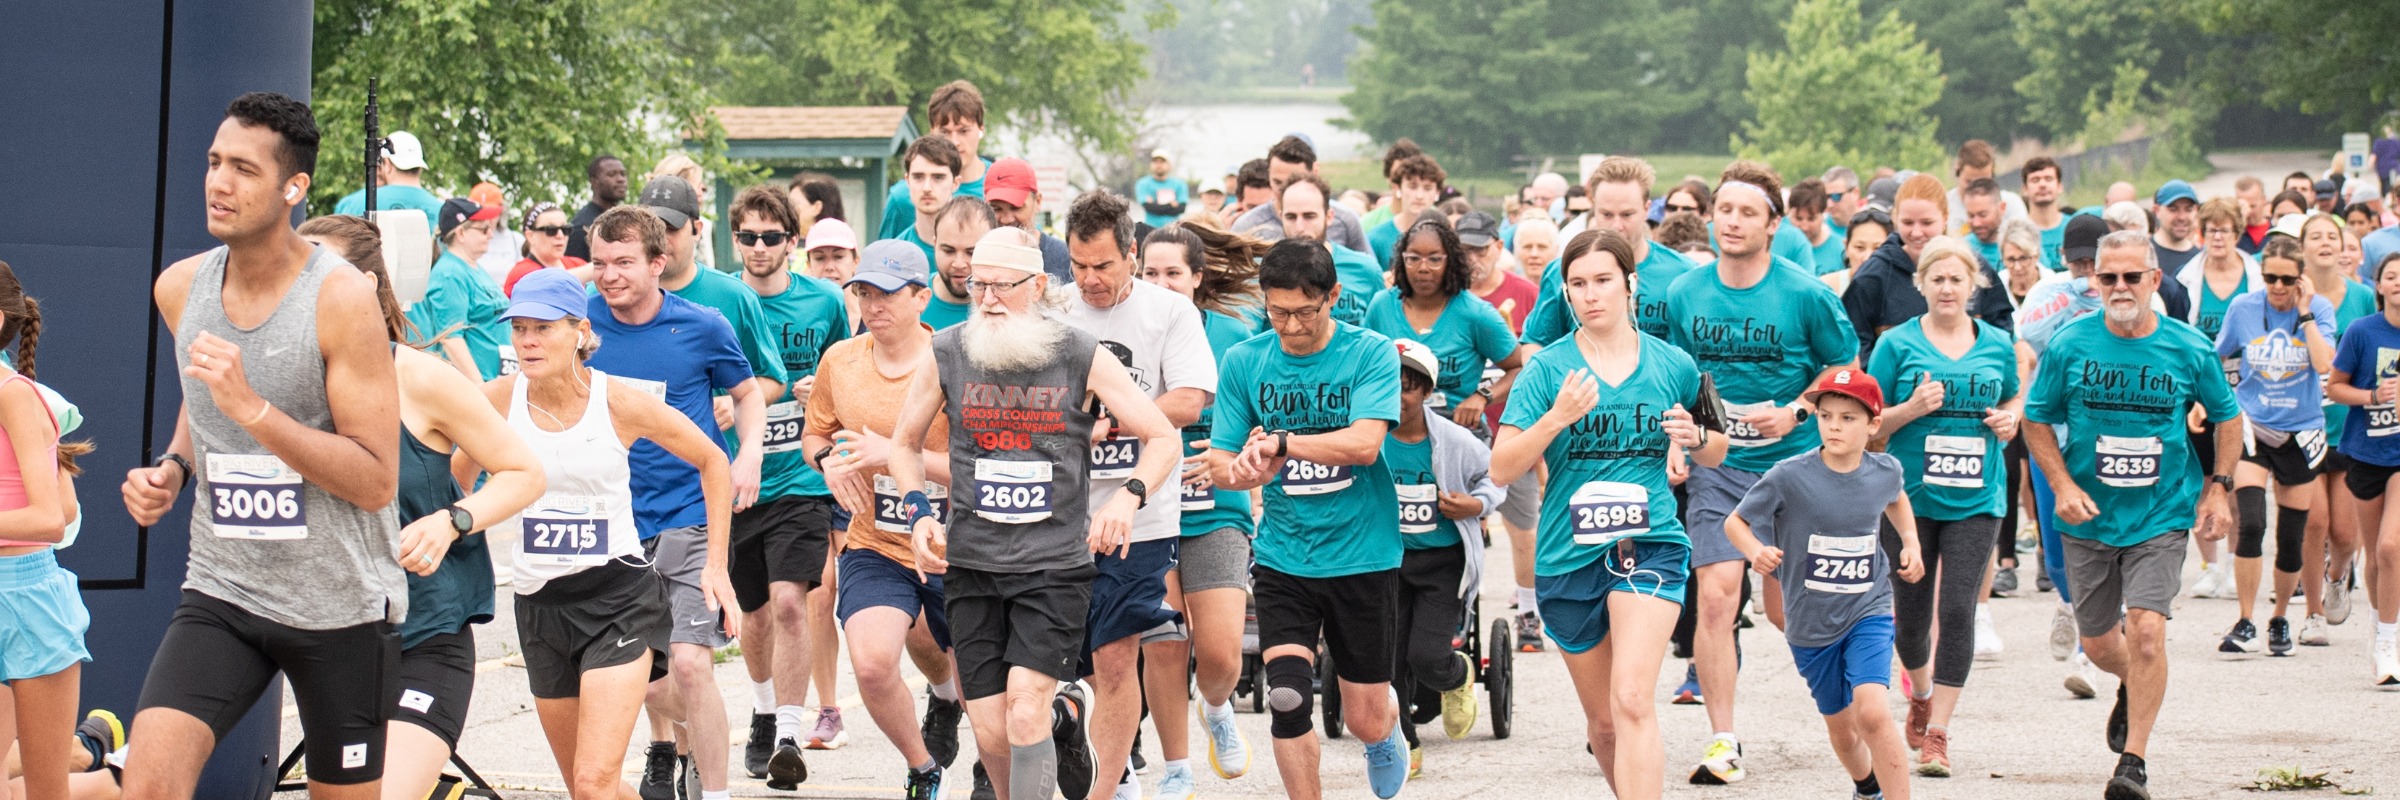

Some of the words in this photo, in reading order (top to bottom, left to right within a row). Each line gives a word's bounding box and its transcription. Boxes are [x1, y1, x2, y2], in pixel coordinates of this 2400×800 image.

[1337, 293, 1360, 311] or
[1692, 315, 1735, 344] Run
[2246, 344, 2271, 361] BIZ
[1912, 371, 1960, 397] Rn
[2082, 359, 2130, 390] Run
[962, 382, 1068, 409] KINNEY
[1258, 381, 1311, 416] Run
[1942, 398, 1955, 409] nd
[2104, 389, 2125, 401] and
[2129, 390, 2176, 406] Learning
[961, 407, 1000, 420] CROSS
[1002, 409, 1064, 423] COUNTRY
[1606, 403, 1635, 411] ANNUAL
[962, 419, 1067, 433] CHAMPIONSHIPS
[1286, 411, 1309, 427] and
[1725, 419, 1760, 437] 269
[2369, 409, 2398, 427] 303
[763, 421, 799, 442] 629
[971, 430, 1032, 451] 1986
[1595, 435, 1621, 450] and
[244, 456, 279, 469] RIVER
[1091, 443, 1135, 465] 024
[1928, 455, 1982, 475] 2640
[2101, 456, 2156, 475] 2639
[215, 488, 299, 519] 3006
[980, 484, 1046, 509] 2602
[881, 498, 941, 521] 263
[1399, 503, 1433, 522] 60
[1577, 504, 1643, 529] 2698
[533, 523, 597, 548] 2715
[1813, 558, 1870, 580] 2746
